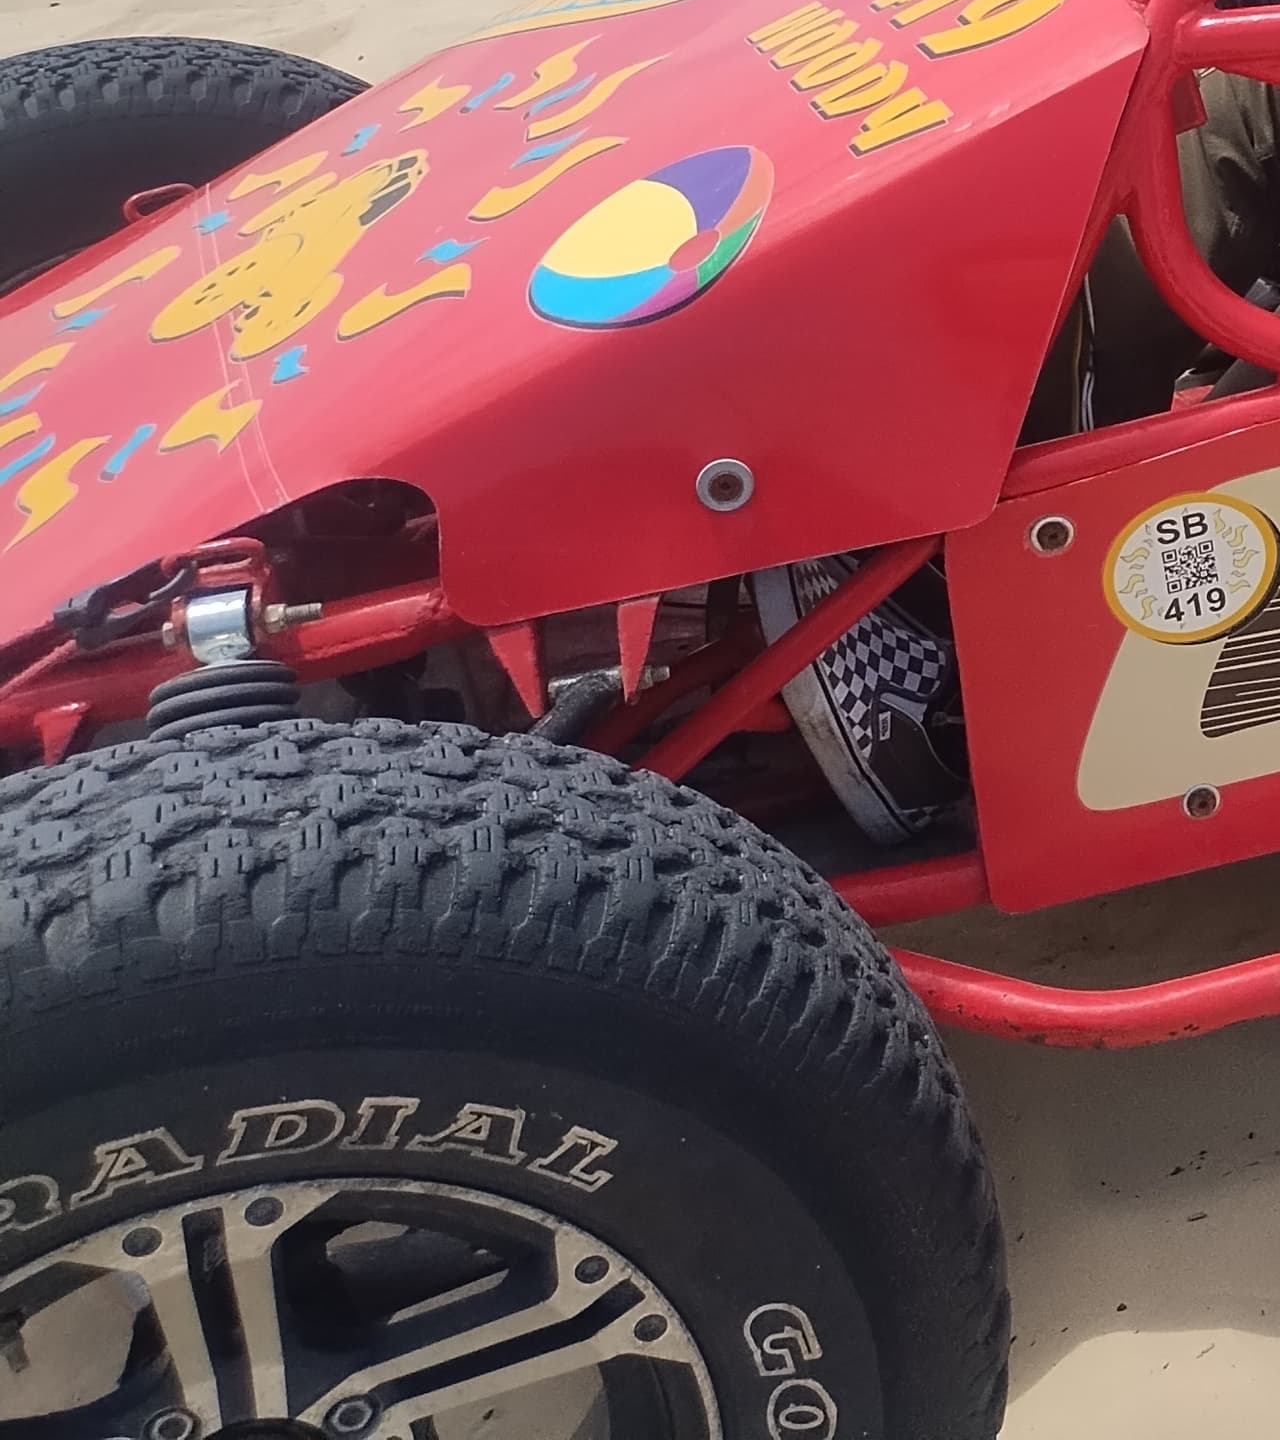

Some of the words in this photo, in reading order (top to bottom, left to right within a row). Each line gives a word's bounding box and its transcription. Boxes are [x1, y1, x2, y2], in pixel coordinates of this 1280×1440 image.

[744, 1, 955, 158] WOODY
[1155, 511, 1209, 546] SB
[1163, 586, 1227, 623] 419
